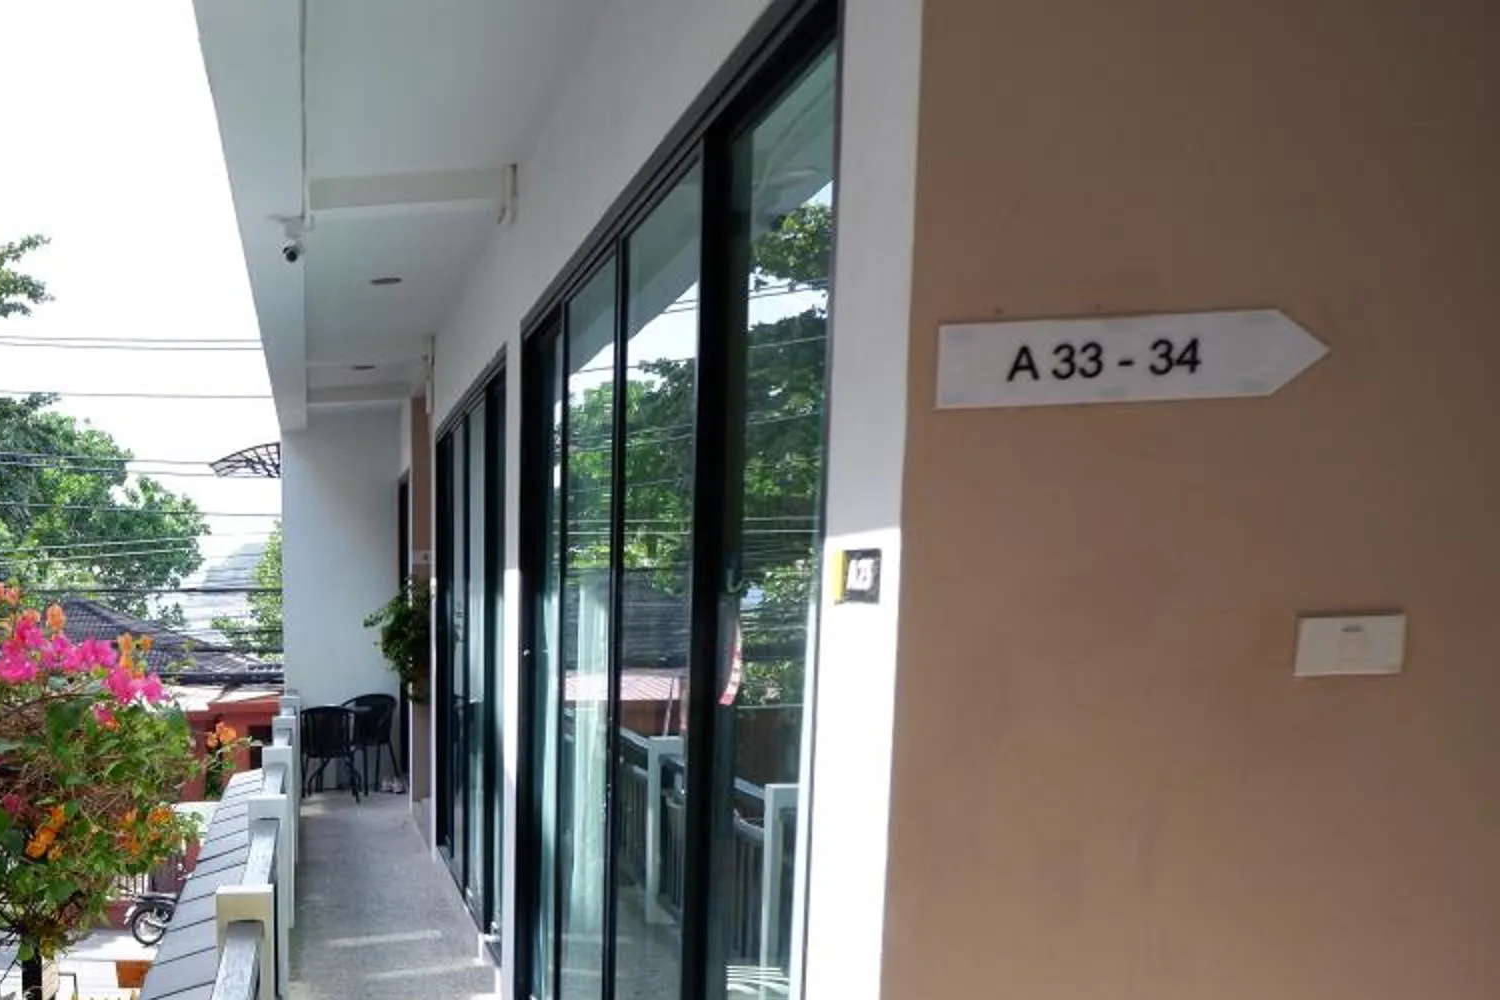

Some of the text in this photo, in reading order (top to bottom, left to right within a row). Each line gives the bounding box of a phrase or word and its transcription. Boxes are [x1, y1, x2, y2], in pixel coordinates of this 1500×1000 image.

[1007, 345, 1040, 382] A
[1052, 342, 1103, 380] 33
[1149, 338, 1202, 376] 34
